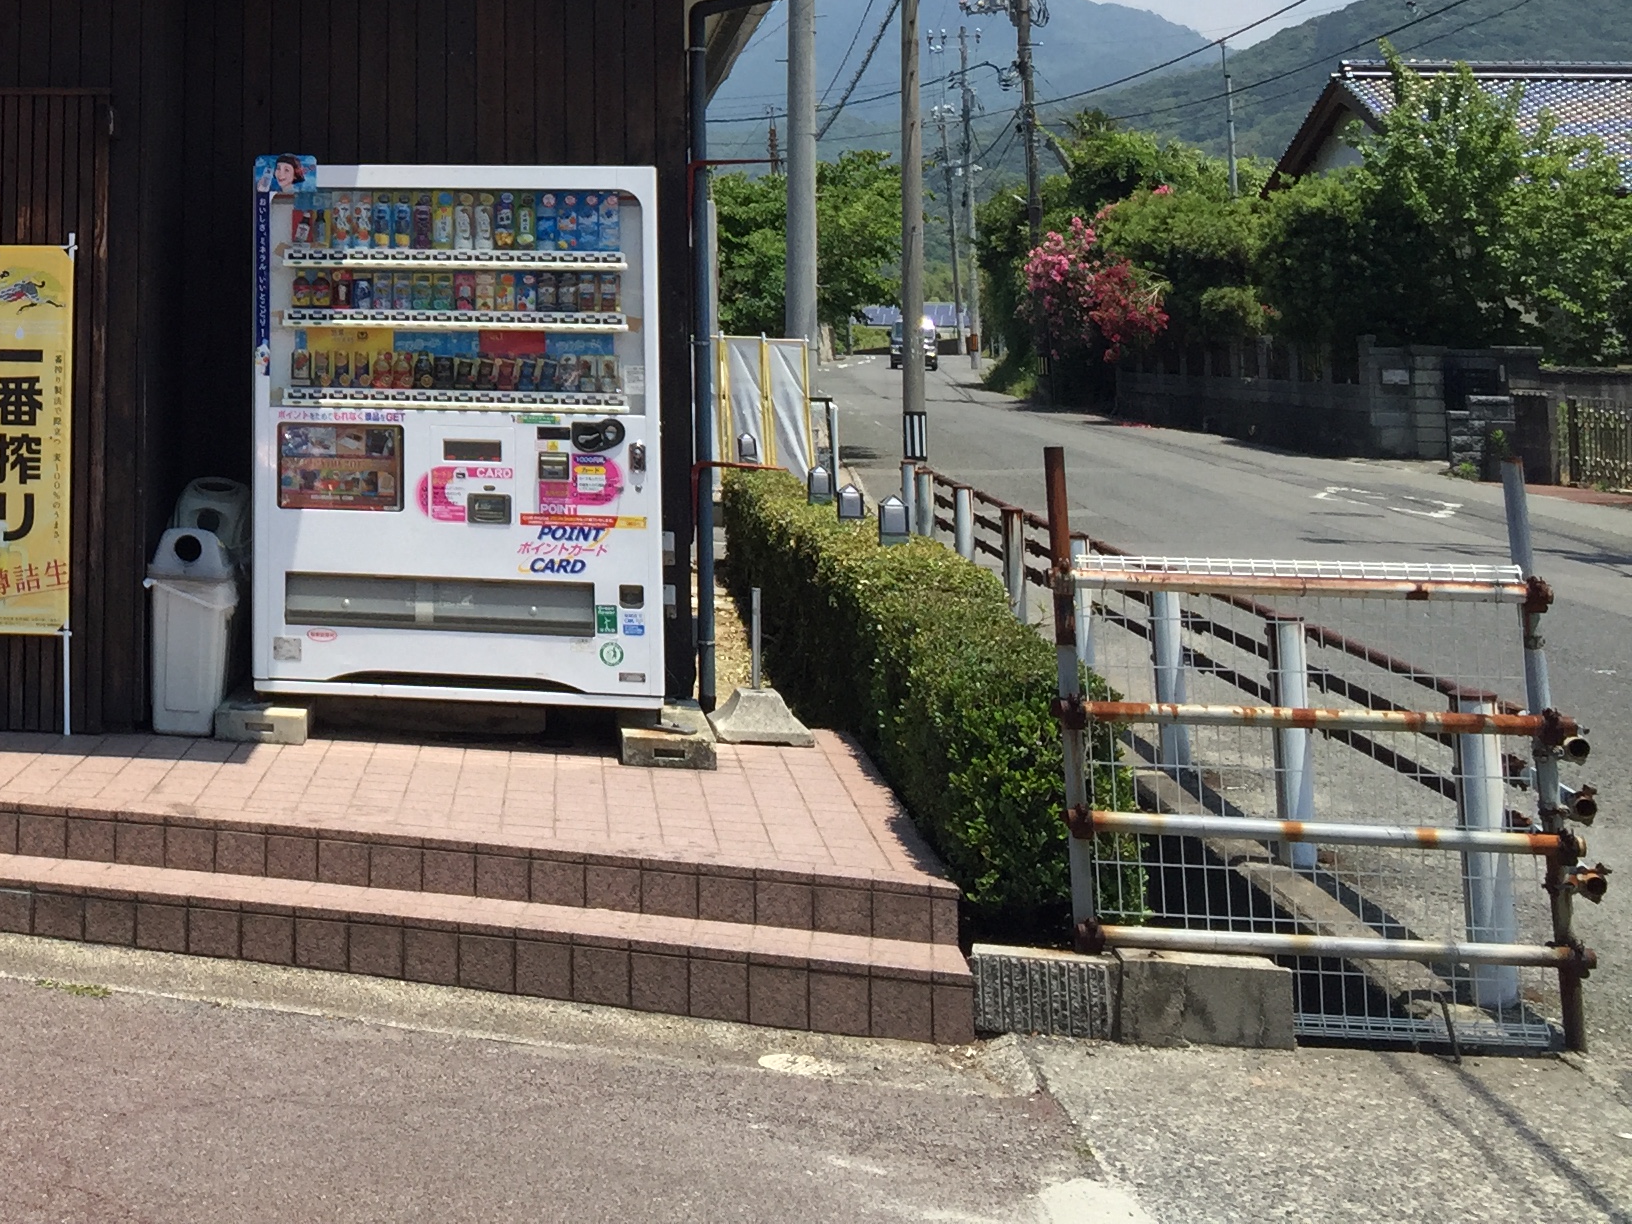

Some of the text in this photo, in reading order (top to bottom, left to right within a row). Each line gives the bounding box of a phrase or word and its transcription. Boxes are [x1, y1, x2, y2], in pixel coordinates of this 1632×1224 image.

[476, 468, 512, 478] CARD
[540, 504, 576, 514] POINT
[537, 526, 605, 542] POINT
[517, 541, 608, 557] ポイントカード
[530, 557, 586, 574] CARD
